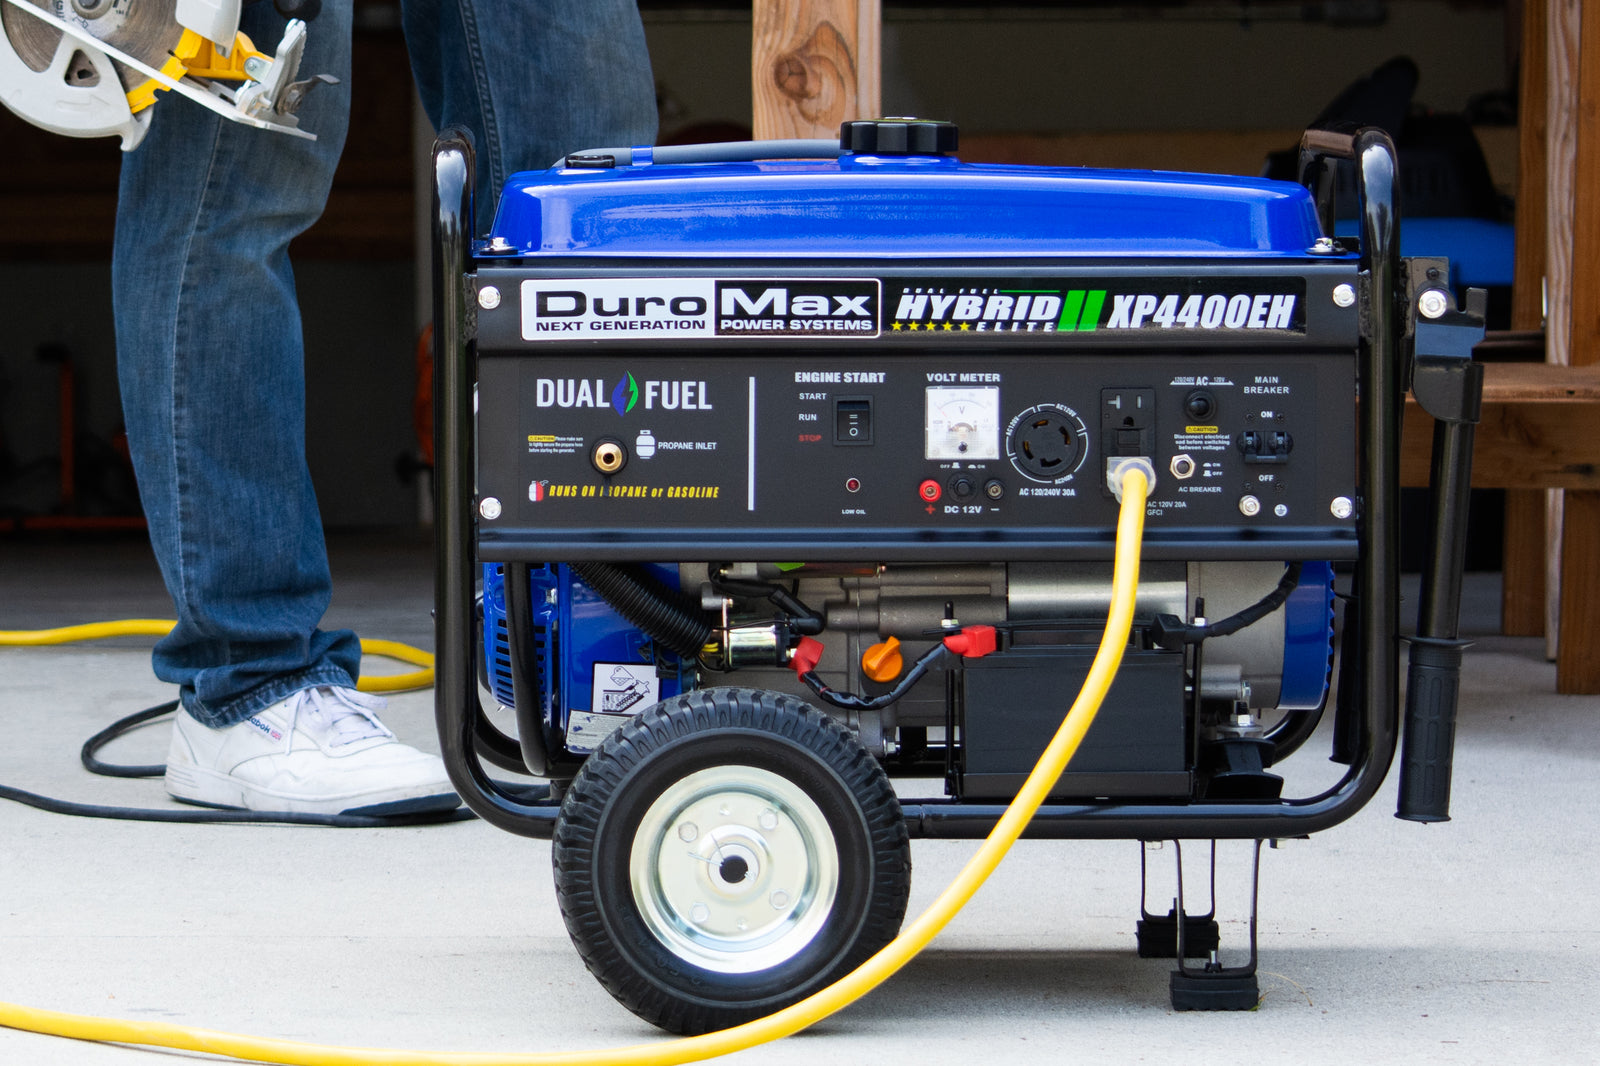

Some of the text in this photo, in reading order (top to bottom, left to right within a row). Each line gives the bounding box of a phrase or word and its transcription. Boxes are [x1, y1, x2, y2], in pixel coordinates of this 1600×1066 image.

[536, 288, 871, 317] Duro Max
[895, 294, 1296, 329] HYBRID XP4400EH
[536, 320, 706, 332] NEXT GENERATION
[720, 319, 872, 331] POWER SYSTEMS
[975, 321, 1055, 333] ELITE
[794, 371, 886, 384] ENGINE START
[926, 372, 1001, 382] VOLT METER
[1196, 376, 1209, 386] AC
[1254, 376, 1279, 384] MAIN
[536, 378, 713, 410] DUAL FUEL
[1243, 386, 1290, 394] BREAKER
[799, 392, 827, 400] START
[798, 413, 818, 421] RUN
[798, 434, 822, 442] STOP
[657, 442, 717, 450] PROPANE INLET
[1258, 474, 1275, 482] OFF
[549, 485, 577, 497] RUNS
[581, 485, 596, 497] ON
[651, 487, 663, 498] or
[667, 486, 720, 498] GASOLINE
[1019, 487, 1029, 496] AC
[1062, 488, 1076, 496] 30A
[944, 505, 982, 514] DC 12V
